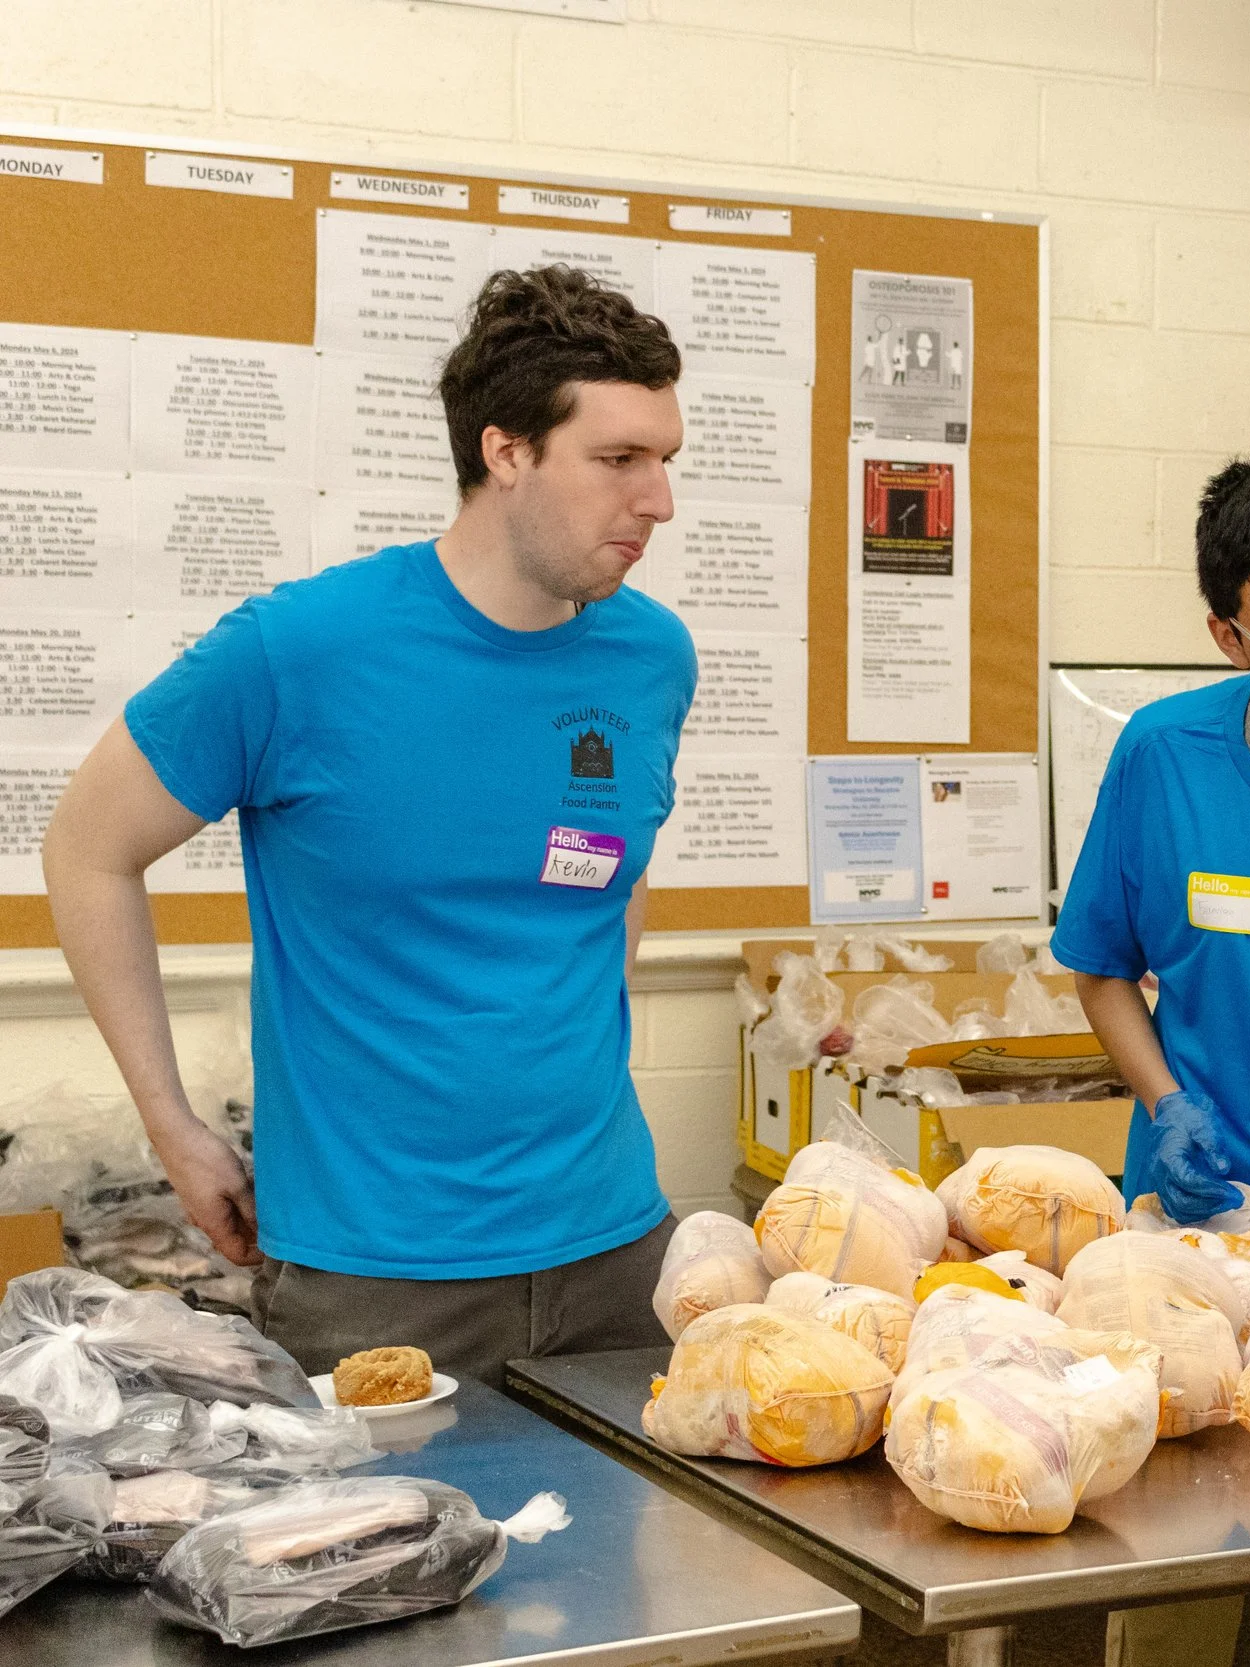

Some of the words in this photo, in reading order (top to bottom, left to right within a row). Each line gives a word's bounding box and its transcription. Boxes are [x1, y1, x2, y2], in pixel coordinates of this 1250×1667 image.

[187, 166, 253, 184] TUESDAY
[357, 178, 445, 198] WEDNESDAY
[531, 192, 600, 210] THURSDAY
[706, 208, 753, 222] FRIDAY
[33, 346, 50, 354] May
[42, 362, 73, 370] Morning
[552, 707, 630, 736] VOLUNTEER
[568, 781, 617, 793] Ascension
[562, 797, 586, 808] Food
[590, 799, 620, 811] Pantry
[551, 830, 588, 850] Hello
[1193, 877, 1229, 893] Hello
